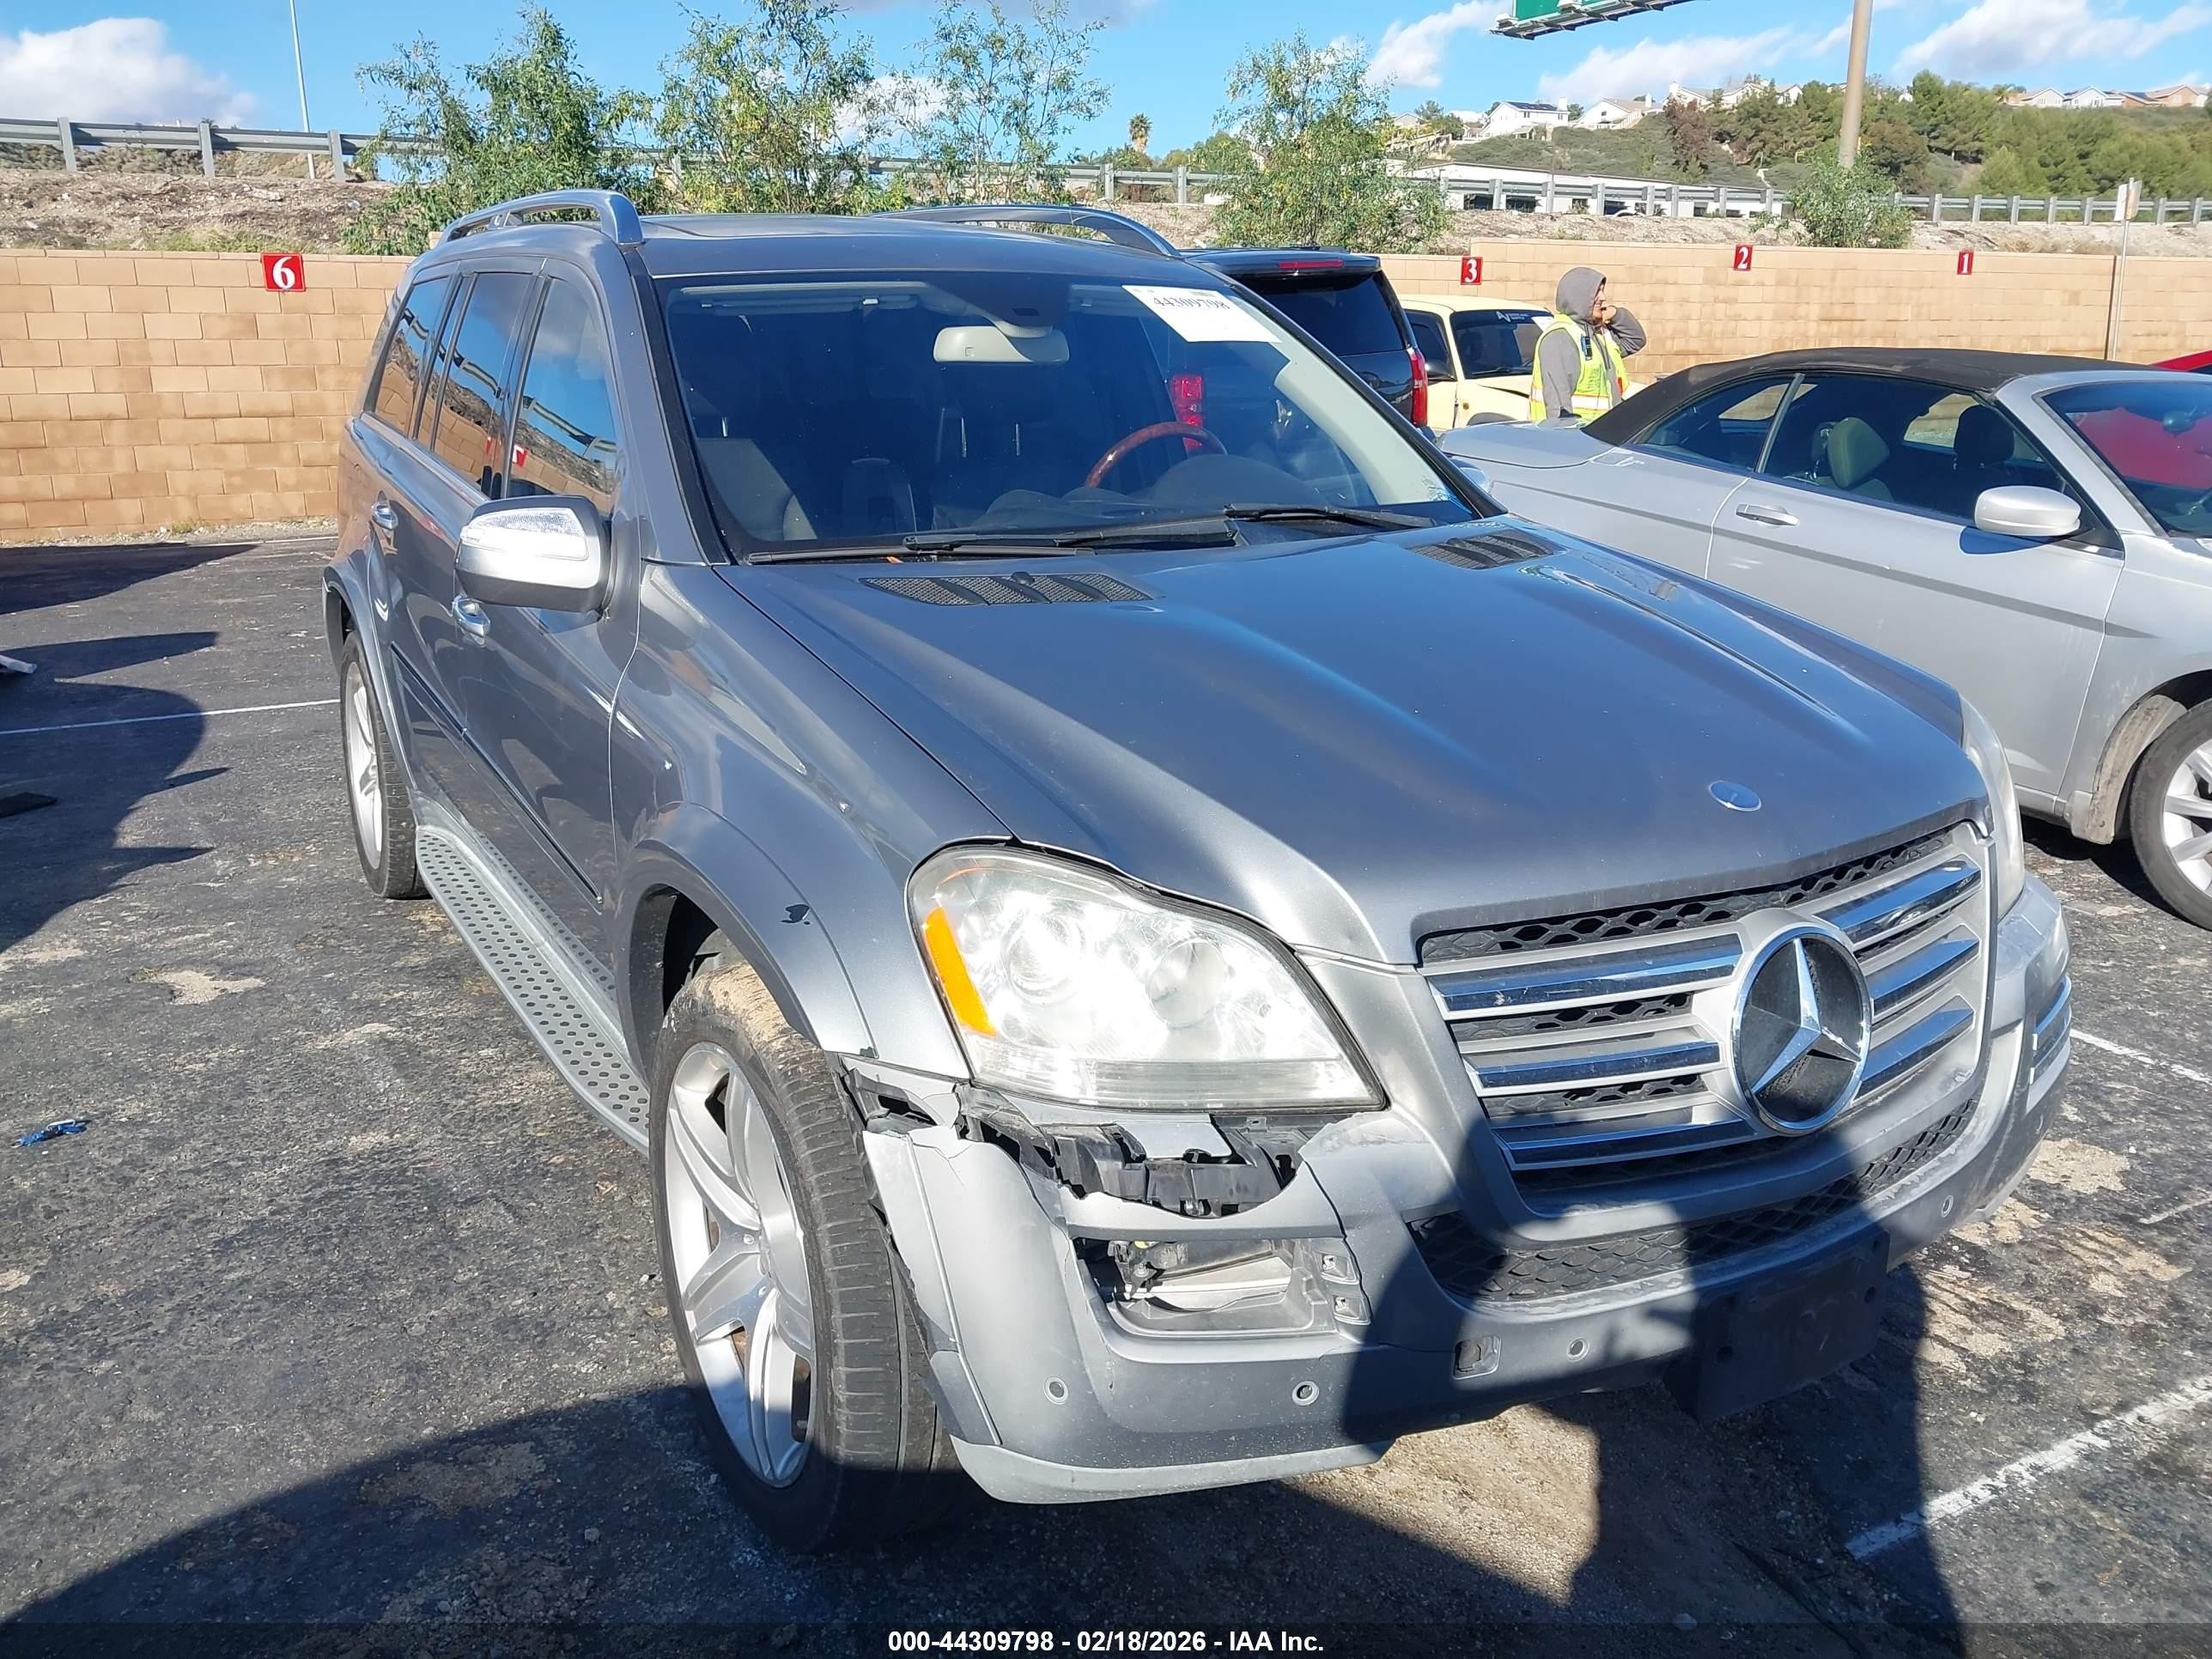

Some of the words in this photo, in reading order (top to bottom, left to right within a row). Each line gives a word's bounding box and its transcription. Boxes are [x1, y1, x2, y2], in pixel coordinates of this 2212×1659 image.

[1736, 246, 1749, 269] 2
[1961, 253, 1969, 274] 1
[272, 256, 296, 290] 6
[1464, 258, 1478, 283] 3
